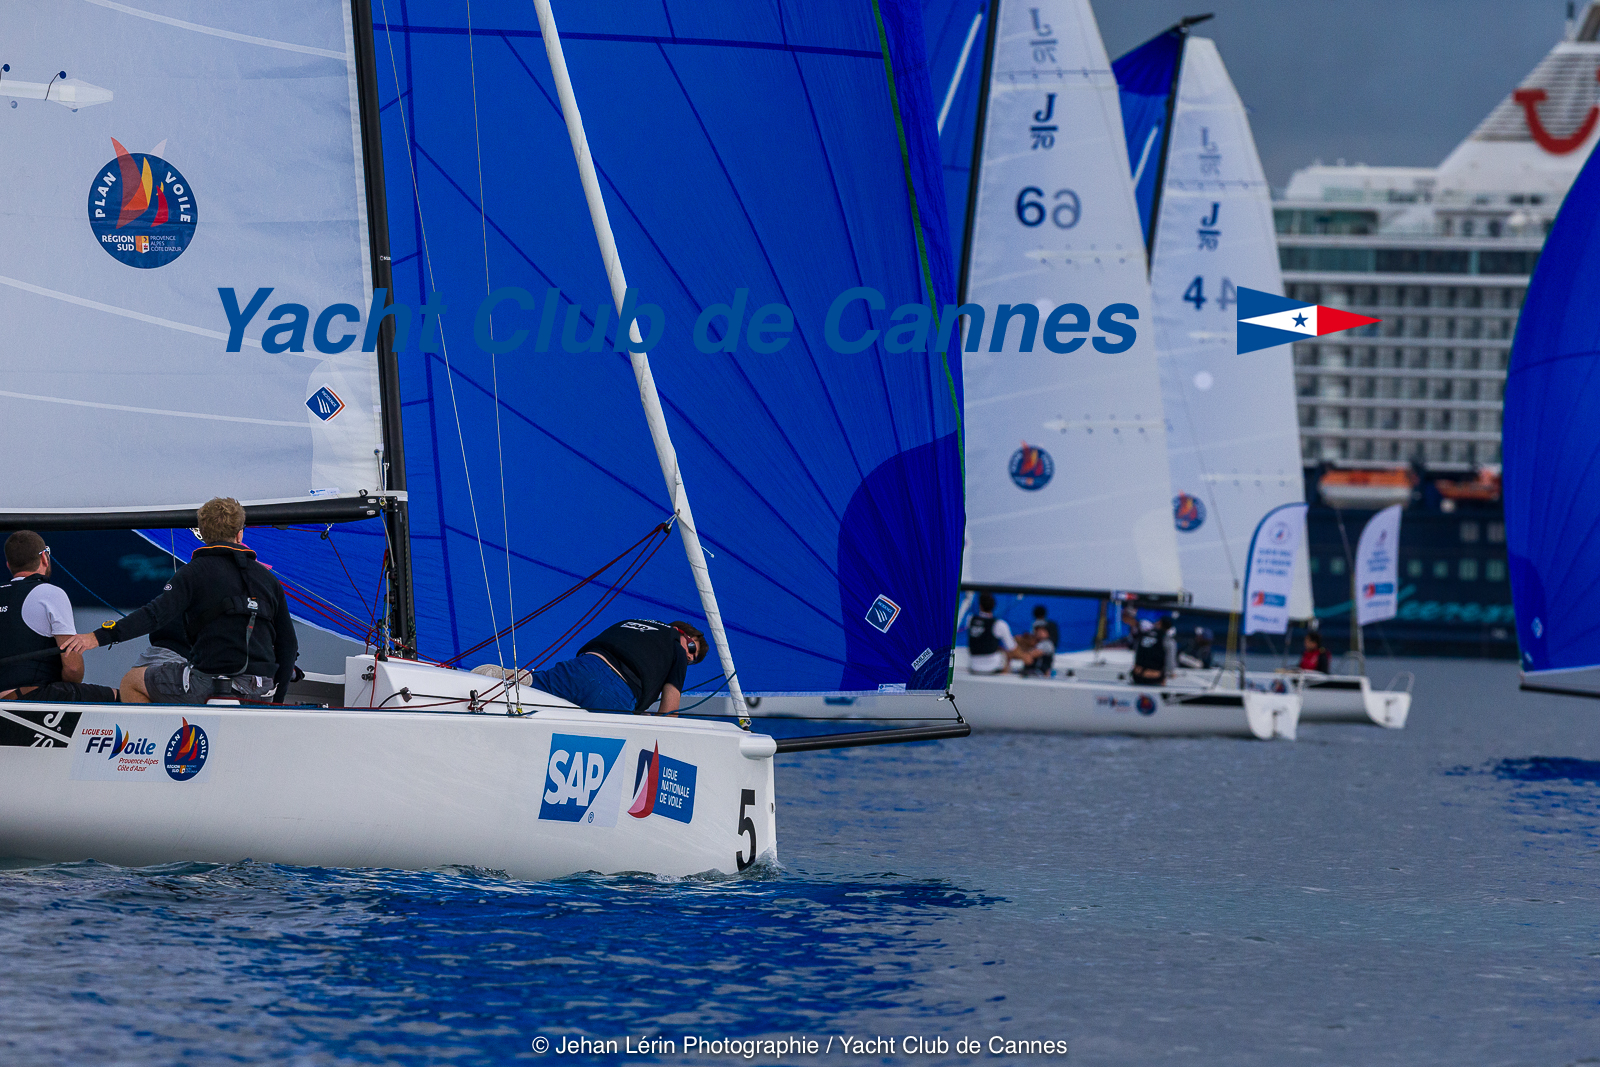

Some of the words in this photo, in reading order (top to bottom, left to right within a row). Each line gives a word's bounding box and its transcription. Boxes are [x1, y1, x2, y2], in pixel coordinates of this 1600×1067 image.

[1033, 92, 1057, 123] J
[95, 171, 117, 218] PLAN
[165, 171, 191, 223] VOILE
[1015, 186, 1047, 229] 6
[1201, 202, 1220, 227] J
[101, 234, 135, 243] RÉGION
[117, 243, 135, 252] SUD
[1182, 275, 1208, 311] 4
[167, 733, 181, 757] PLAN
[119, 757, 159, 766] Provence-Alpes
[663, 766, 678, 781] LIGUE
[544, 750, 605, 806] SAP
[661, 779, 690, 799] NATIONALE
[660, 792, 667, 804] DE
[668, 794, 683, 809] VOILE
[736, 789, 757, 871] 5
